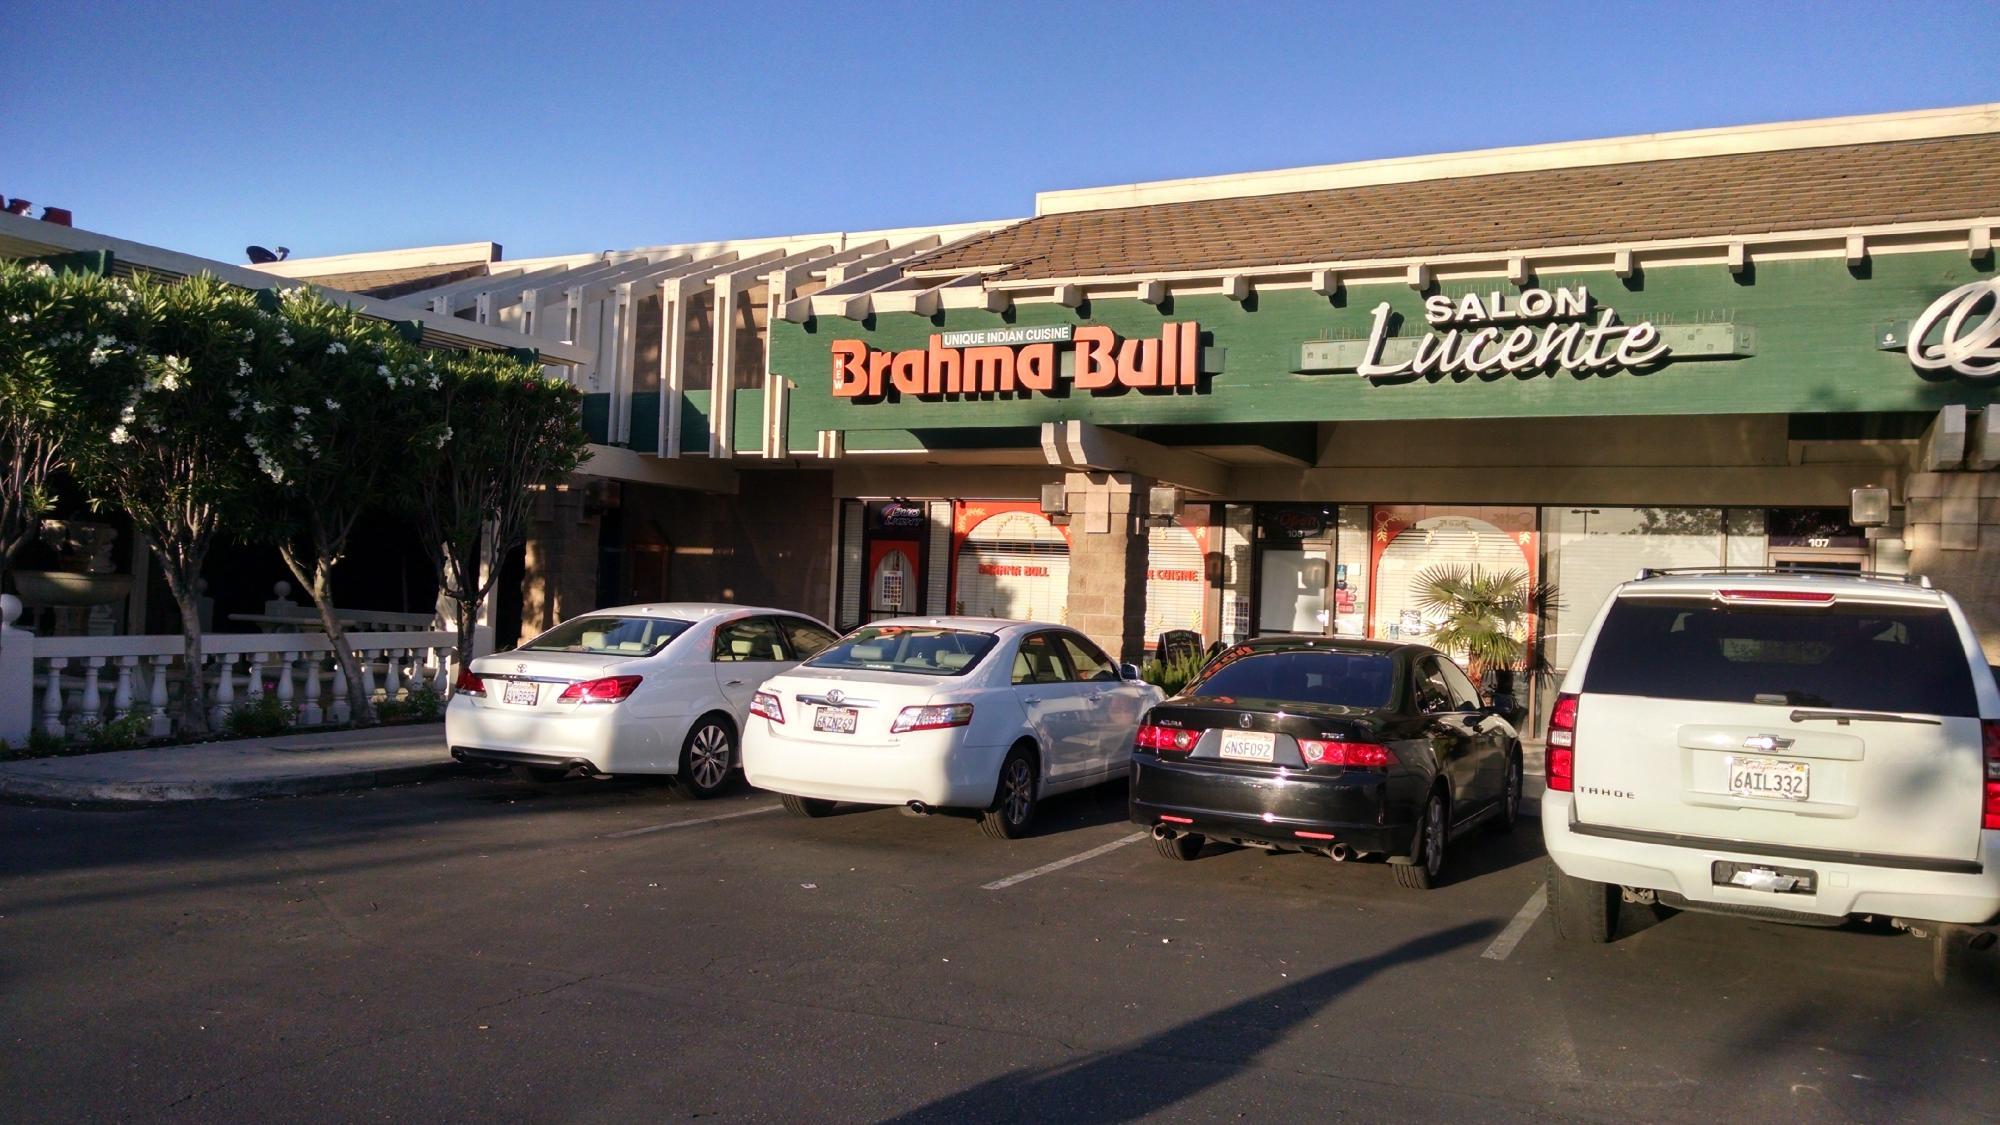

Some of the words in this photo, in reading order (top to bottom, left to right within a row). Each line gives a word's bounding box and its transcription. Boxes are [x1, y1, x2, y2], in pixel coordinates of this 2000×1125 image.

[1425, 285, 1588, 324] SALON
[944, 332, 986, 346] UNIQUE
[986, 330, 1024, 344] INDIAN
[1025, 326, 1070, 341] CUISINE
[1357, 301, 1669, 378] Lucente
[831, 334, 1054, 397] Brahma
[1073, 322, 1198, 390] Bull
[833, 358, 844, 390] NEW
[1808, 538, 1830, 548] 107
[1157, 568, 1199, 582] CUISINE
[1224, 739, 1272, 758] 6NSF092
[1579, 785, 1636, 800] TAHOE
[1734, 771, 1803, 794] 6AIL332
